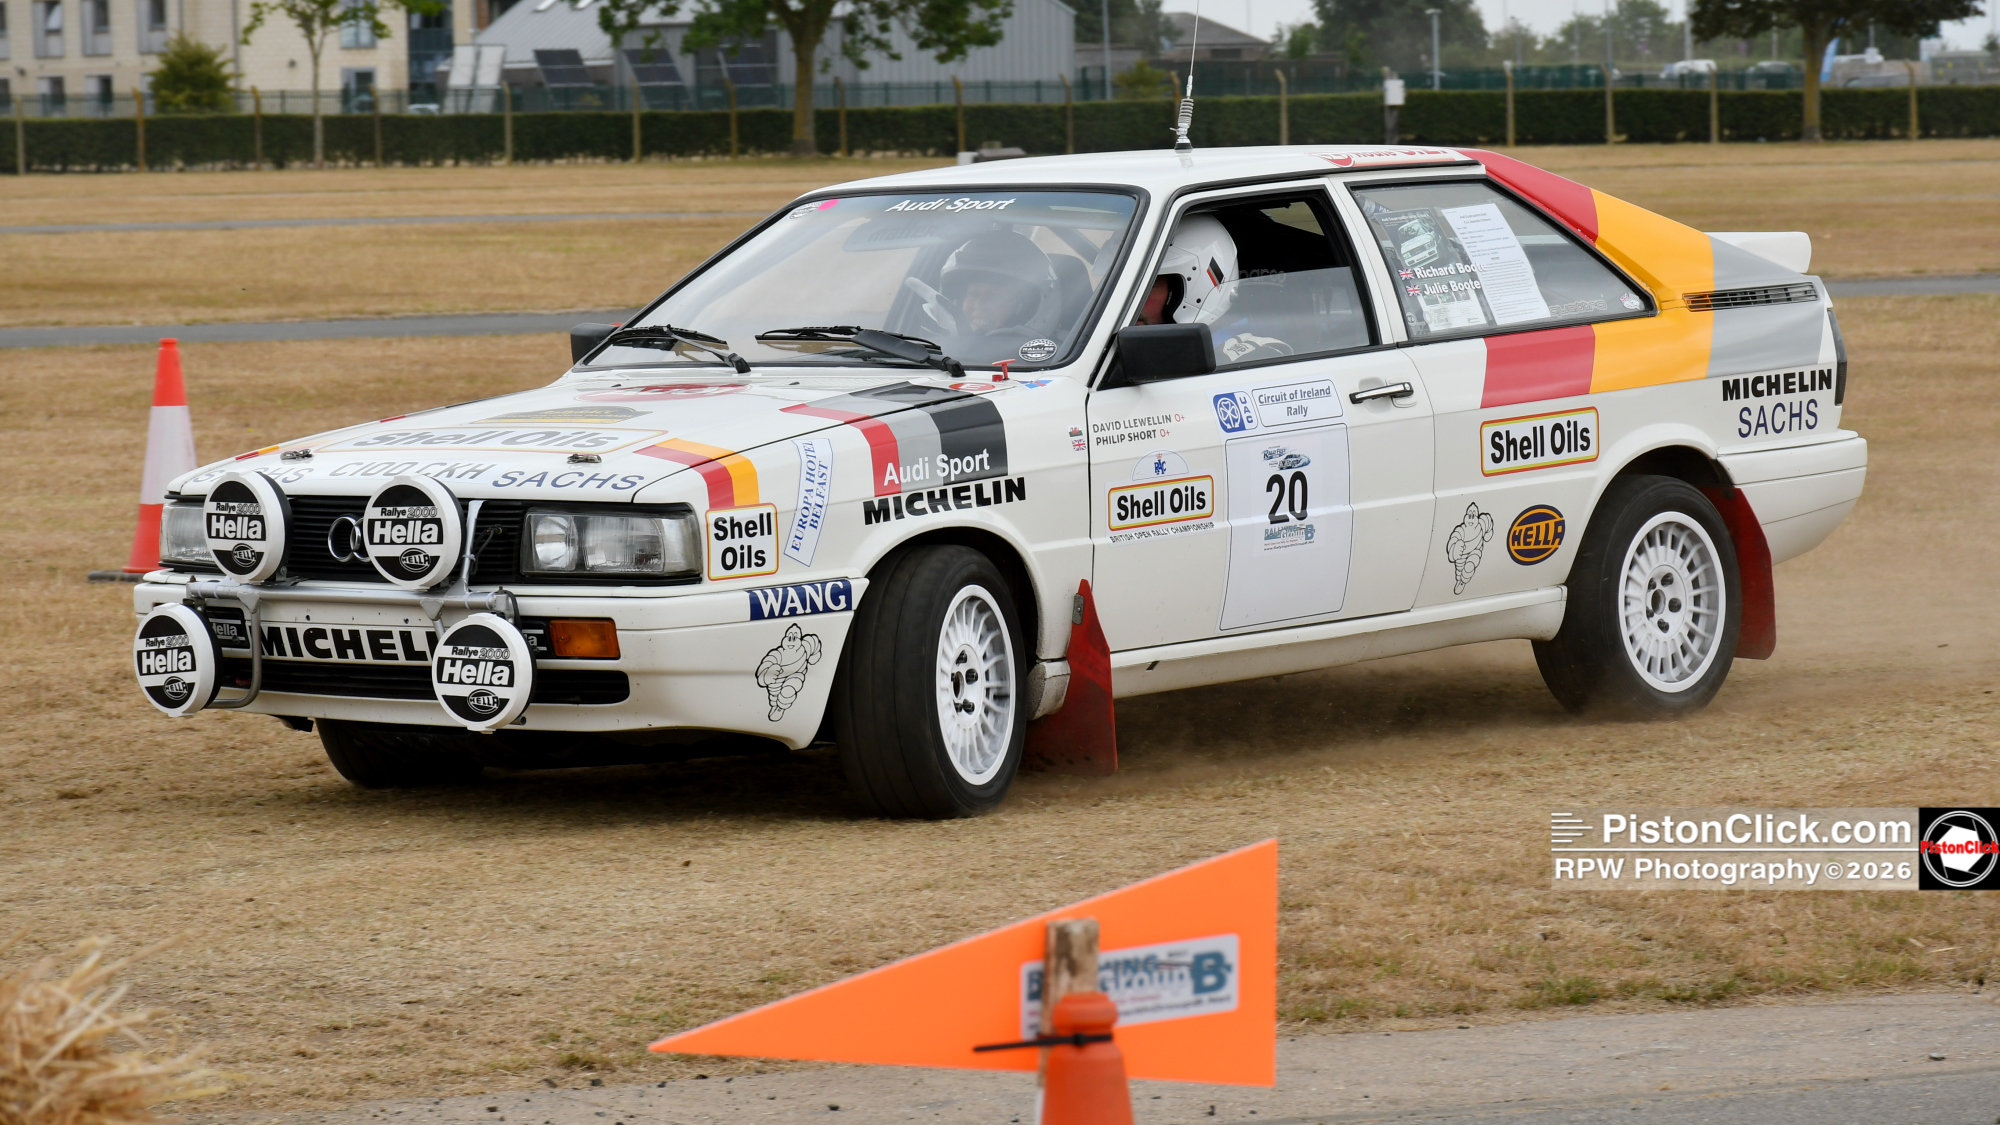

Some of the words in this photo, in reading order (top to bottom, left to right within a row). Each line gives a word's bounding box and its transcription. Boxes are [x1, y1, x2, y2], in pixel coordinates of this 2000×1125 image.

[885, 198, 948, 212] Audi
[945, 197, 1016, 213] Sport
[1414, 262, 1455, 279] Richard
[1456, 260, 1488, 275] Boote
[1423, 281, 1448, 296] Julie
[1450, 279, 1481, 293] Boote
[1258, 391, 1287, 404] Circuit
[1289, 389, 1298, 400] of
[1300, 385, 1331, 399] Ireland
[1722, 368, 1833, 401] MICHELIN
[1286, 405, 1308, 417] Rally
[1738, 398, 1818, 438] SACHS
[1092, 420, 1122, 434] DAVID
[1123, 414, 1172, 429] LLEWELLIN
[353, 429, 507, 448] Shell
[502, 430, 620, 449] Oils
[1096, 433, 1126, 446] PHILIP
[1127, 429, 1157, 442] SHORT
[1490, 425, 1545, 464] Shell
[1550, 419, 1591, 455] Oils
[328, 461, 419, 477] C100
[883, 456, 930, 486] Audi
[936, 447, 990, 481] Sport
[492, 471, 647, 491] SACHS
[791, 487, 814, 552] EUROPA
[803, 440, 816, 485] HOTEL
[808, 460, 829, 531] BELFAST
[862, 476, 1027, 526] MICHELIN
[1116, 489, 1165, 522] Shell
[1169, 485, 1206, 514] Oils
[1265, 470, 1308, 525] 20
[216, 502, 236, 515] Rallye
[236, 503, 262, 515] 2000
[380, 507, 407, 519] Rallye
[407, 507, 438, 518] 2000
[211, 514, 263, 540] Hella
[373, 520, 439, 544] Hella
[713, 512, 772, 542] Shell
[1109, 532, 1134, 544] BRITISH
[1134, 529, 1151, 541] OPEN
[1151, 527, 1170, 538] RALLY
[1170, 521, 1215, 535] CHAMPIONSHIP
[1511, 518, 1566, 547] HELLA
[233, 549, 257, 561] HELLA
[401, 556, 431, 565] HELLA
[720, 544, 767, 571] Oils
[752, 581, 847, 618] WANG
[145, 637, 165, 648] Rallye
[165, 634, 190, 648] 2000
[141, 648, 192, 675] Hella
[451, 646, 479, 658] Rallye
[478, 647, 511, 660] 2000
[441, 659, 510, 686] Hella
[164, 681, 188, 693] HELLA
[469, 695, 499, 708] HELLA
[1191, 951, 1228, 995] B
